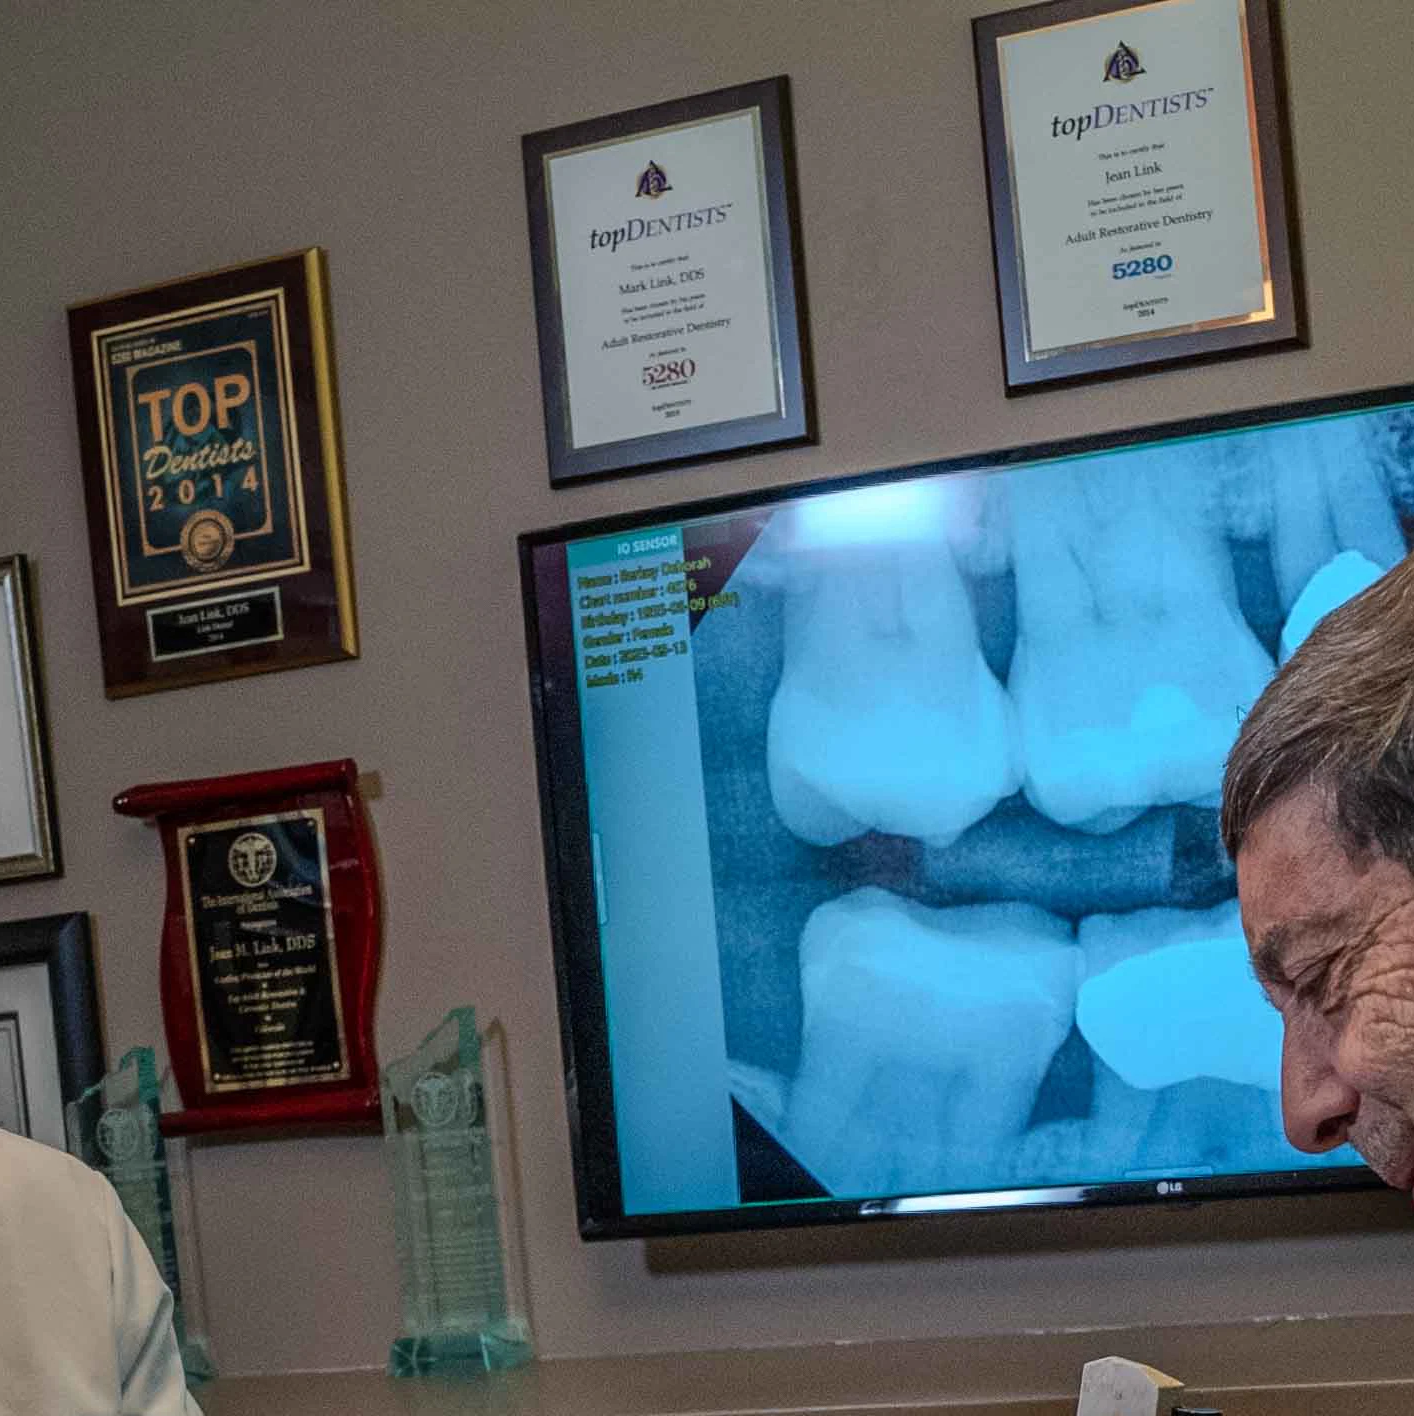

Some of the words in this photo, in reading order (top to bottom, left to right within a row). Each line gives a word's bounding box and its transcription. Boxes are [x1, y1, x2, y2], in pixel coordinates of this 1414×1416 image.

[1104, 170, 1131, 185] Jean
[1133, 161, 1163, 177] Link
[1065, 231, 1096, 245] Adult
[1099, 220, 1160, 239] Restorative
[1162, 210, 1213, 227] Dentistry
[1111, 254, 1173, 280] 5280
[619, 280, 646, 295] Mark
[680, 269, 705, 283] DDS
[601, 337, 629, 350] Adult
[630, 327, 684, 344] Restorative
[686, 317, 732, 333] Dentistry
[133, 339, 183, 362] MAGAZINE
[642, 359, 696, 385] 5280
[137, 372, 251, 442] TOP
[143, 438, 257, 481] Dentists
[618, 542, 631, 555] IO
[632, 535, 678, 553] SENSOR
[286, 933, 316, 952] DDS
[1170, 1182, 1183, 1191] LG
